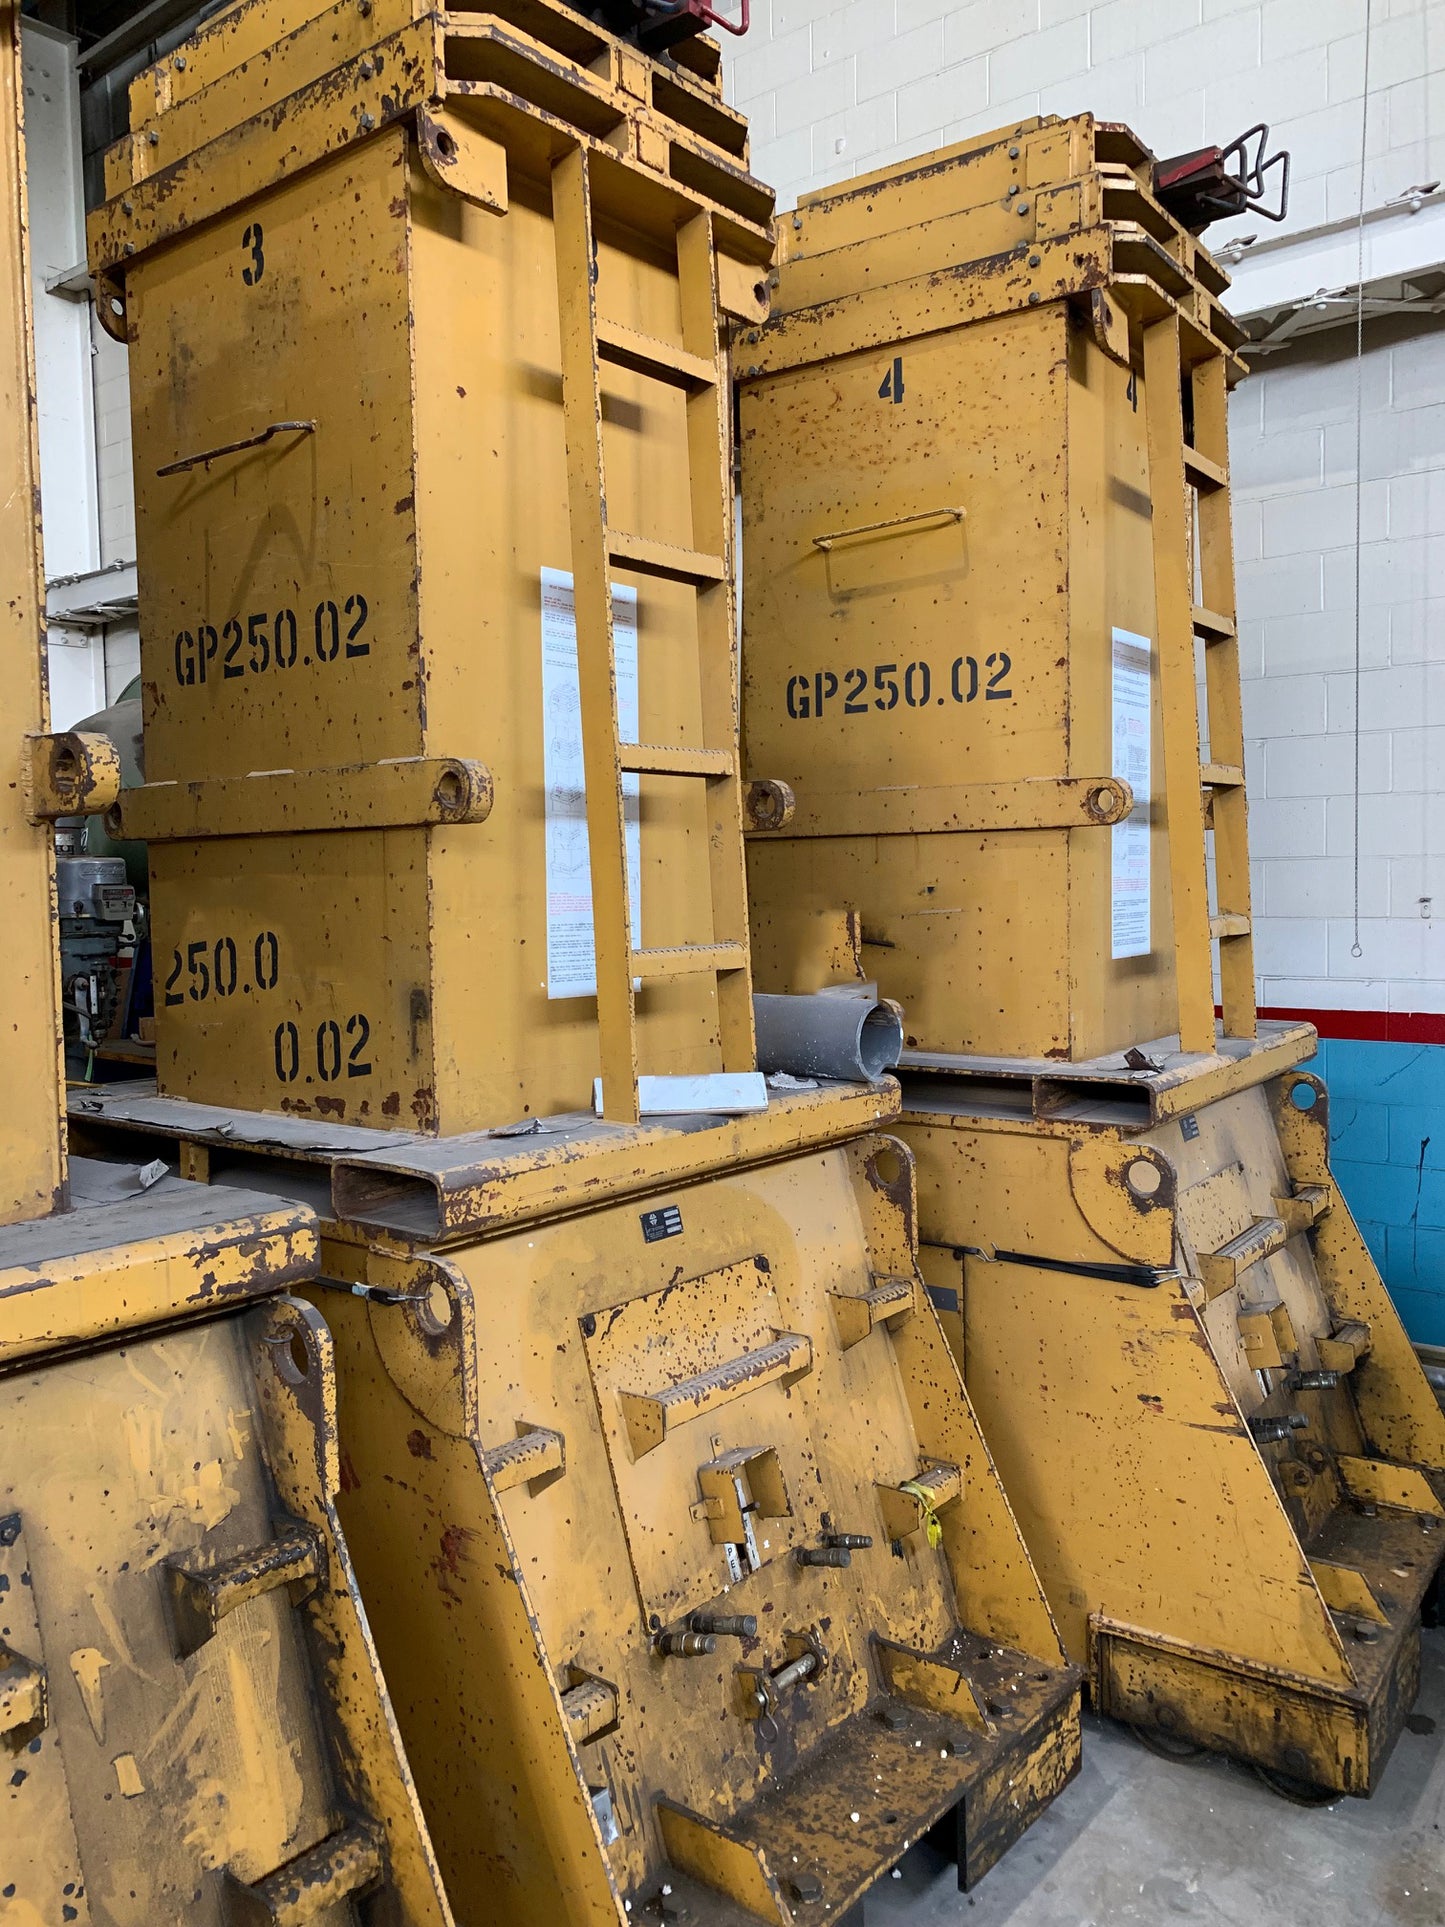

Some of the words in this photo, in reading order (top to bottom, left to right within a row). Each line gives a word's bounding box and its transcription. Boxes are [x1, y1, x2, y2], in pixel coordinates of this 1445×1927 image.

[242, 223, 265, 286] 3
[878, 357, 905, 404] 4
[175, 594, 370, 687] GP250.02
[786, 652, 1012, 720] GP250.02
[165, 931, 279, 1007] 250.0
[275, 1013, 372, 1083] 0.02
